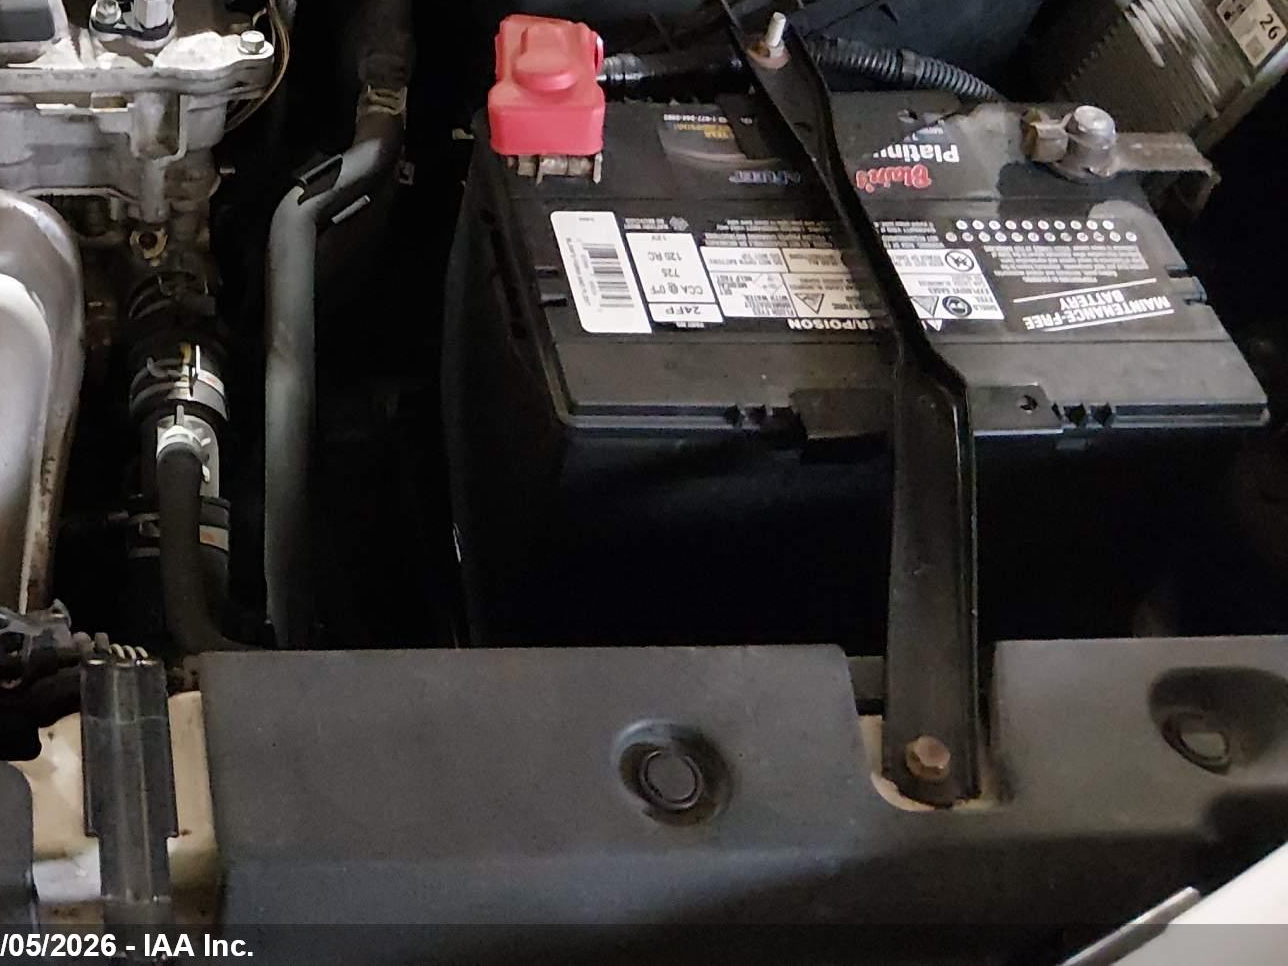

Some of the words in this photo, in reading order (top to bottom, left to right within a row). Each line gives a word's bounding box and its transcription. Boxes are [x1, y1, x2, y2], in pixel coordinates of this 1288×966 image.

[1259, 12, 1281, 41] 26
[647, 251, 663, 261] RC
[665, 251, 682, 261] 120
[661, 267, 680, 278] 725
[681, 284, 704, 295] CCA
[1060, 290, 1125, 311] BATTERY
[1022, 295, 1172, 331] MAINTENANCE-FREE
